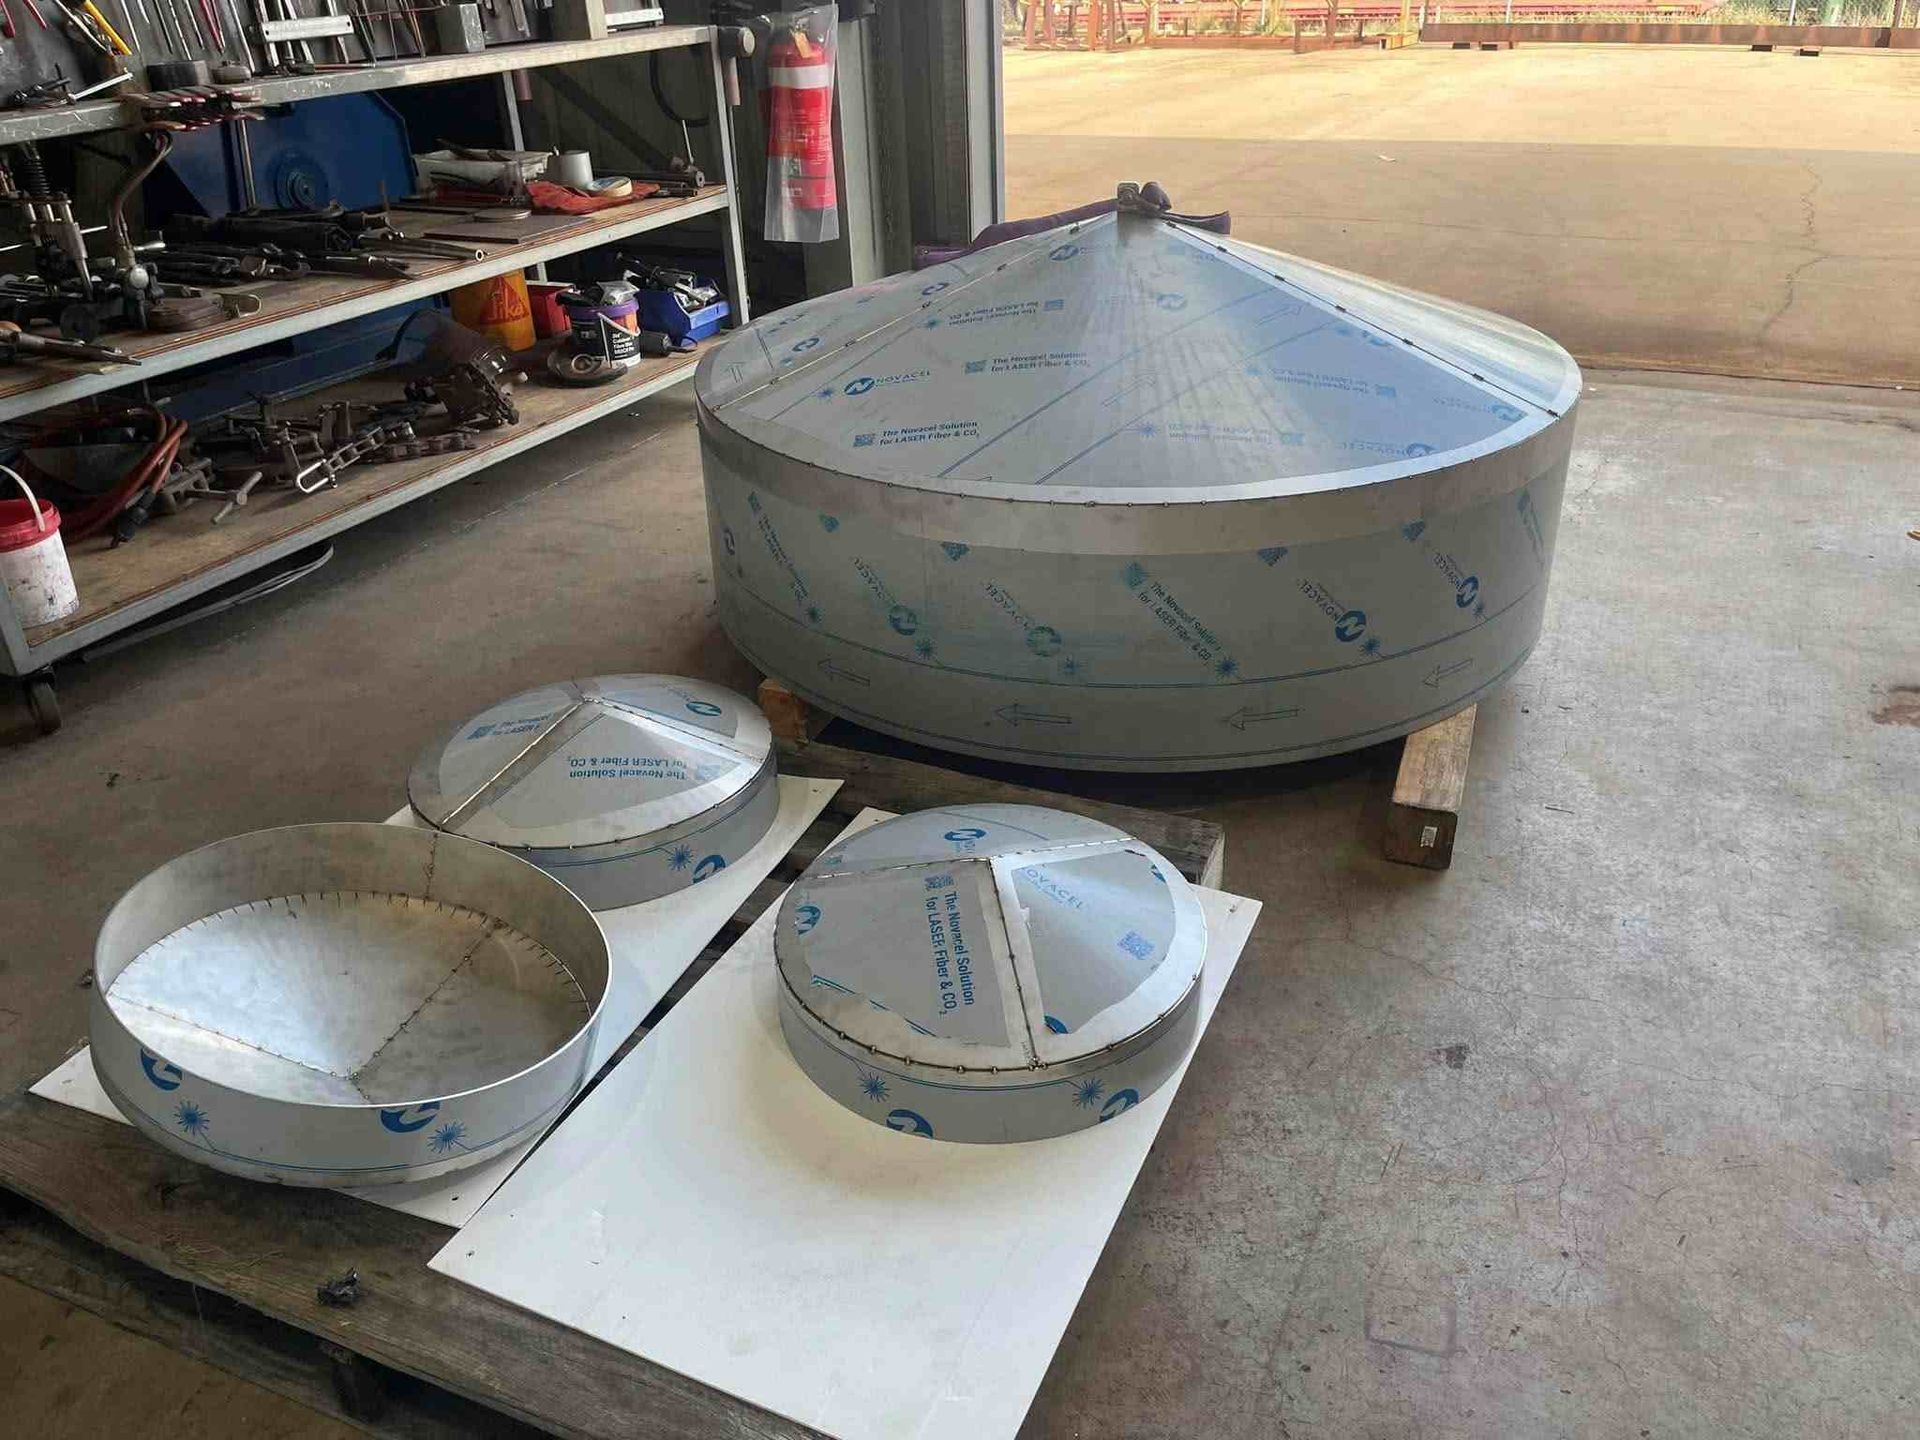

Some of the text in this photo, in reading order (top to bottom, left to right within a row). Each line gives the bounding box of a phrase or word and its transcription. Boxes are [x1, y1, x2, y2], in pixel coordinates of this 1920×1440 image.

[901, 424, 937, 435] Novacel
[939, 421, 978, 431] Solution
[590, 757, 598, 766] &
[600, 756, 629, 767] Fiber
[632, 756, 669, 767] LASER
[569, 768, 686, 780] The Novacel Solution
[925, 895, 939, 911] for
[927, 912, 946, 949] LASER
[944, 891, 976, 1007] The Novacel Solution
[934, 949, 950, 978] Fiber
[939, 981, 954, 991] &
